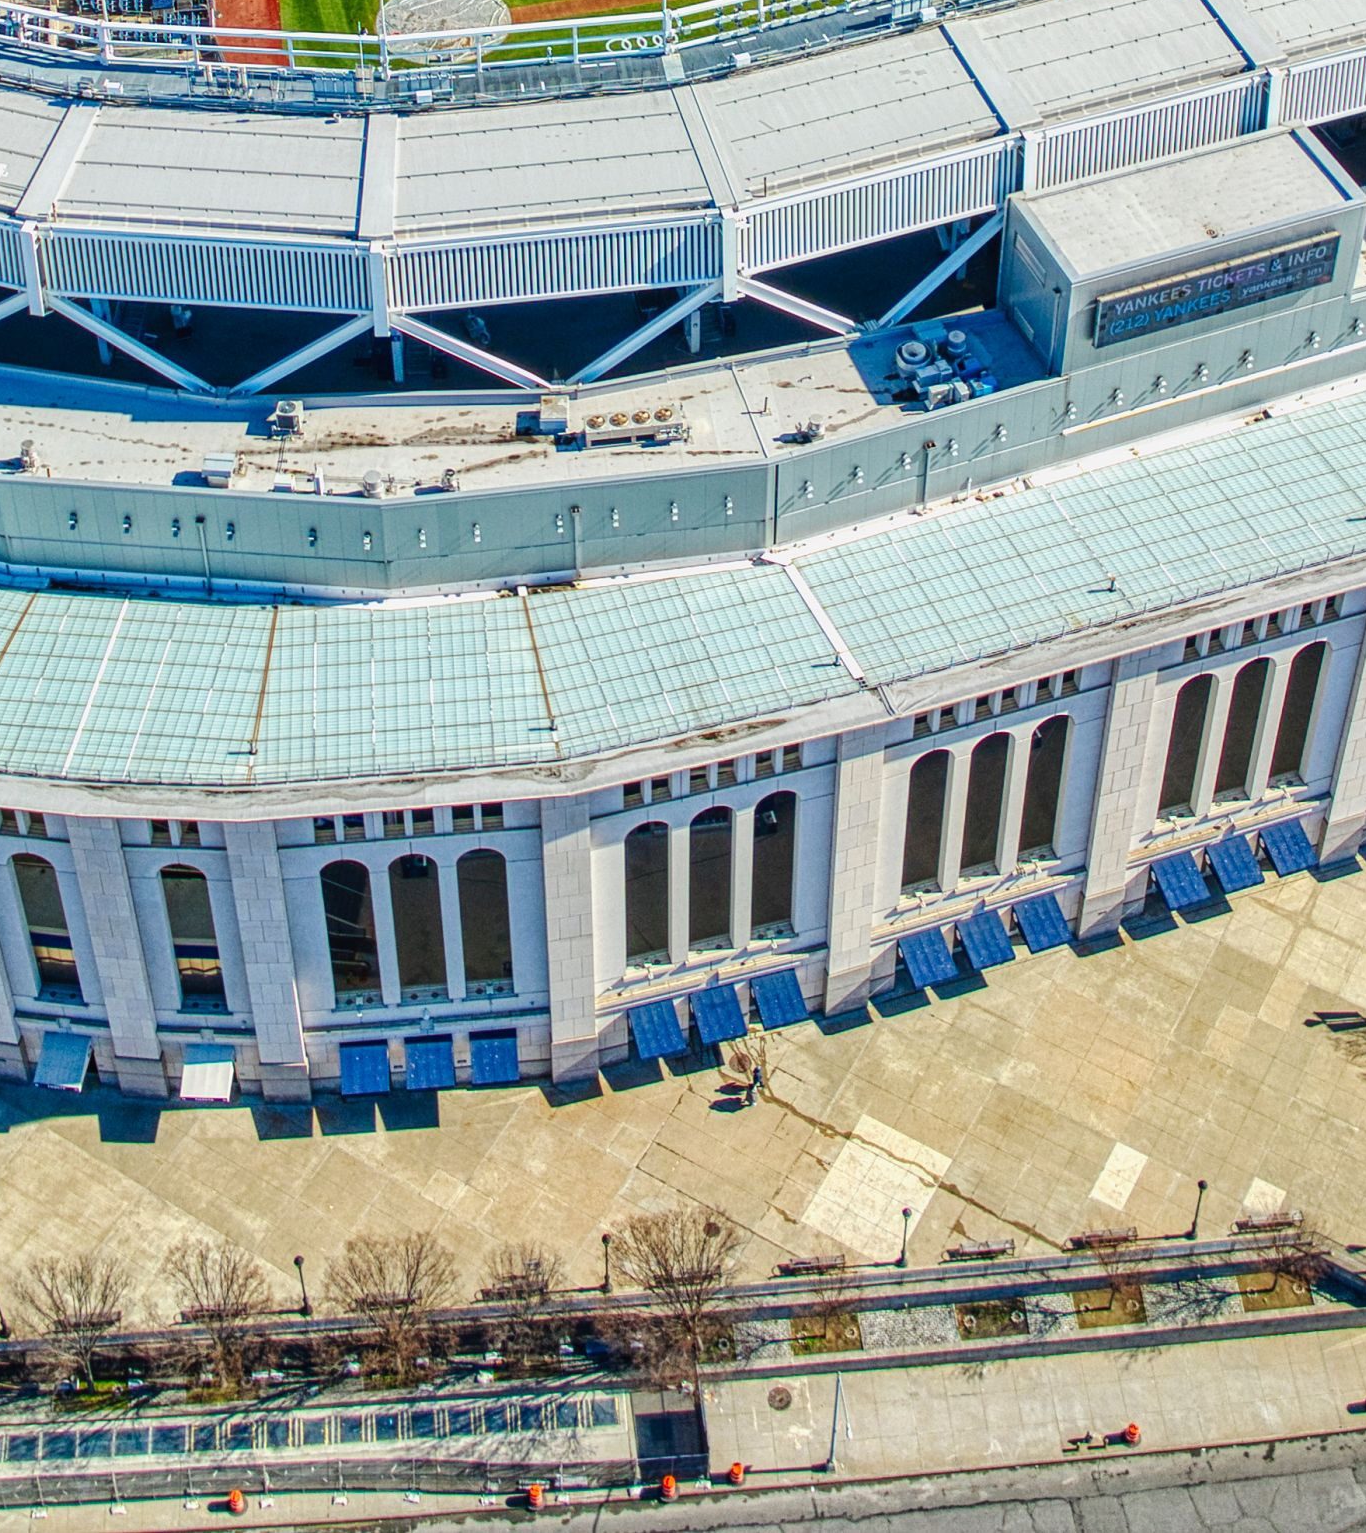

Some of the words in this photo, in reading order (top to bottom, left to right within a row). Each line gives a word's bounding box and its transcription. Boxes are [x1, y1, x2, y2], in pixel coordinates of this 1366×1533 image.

[1114, 284, 1192, 316] YANKEES
[1198, 263, 1265, 293] TICKETS
[1270, 257, 1282, 272] &
[1288, 245, 1327, 267] INFO
[1109, 315, 1150, 335] (212)
[1154, 290, 1231, 322] YANKEES
